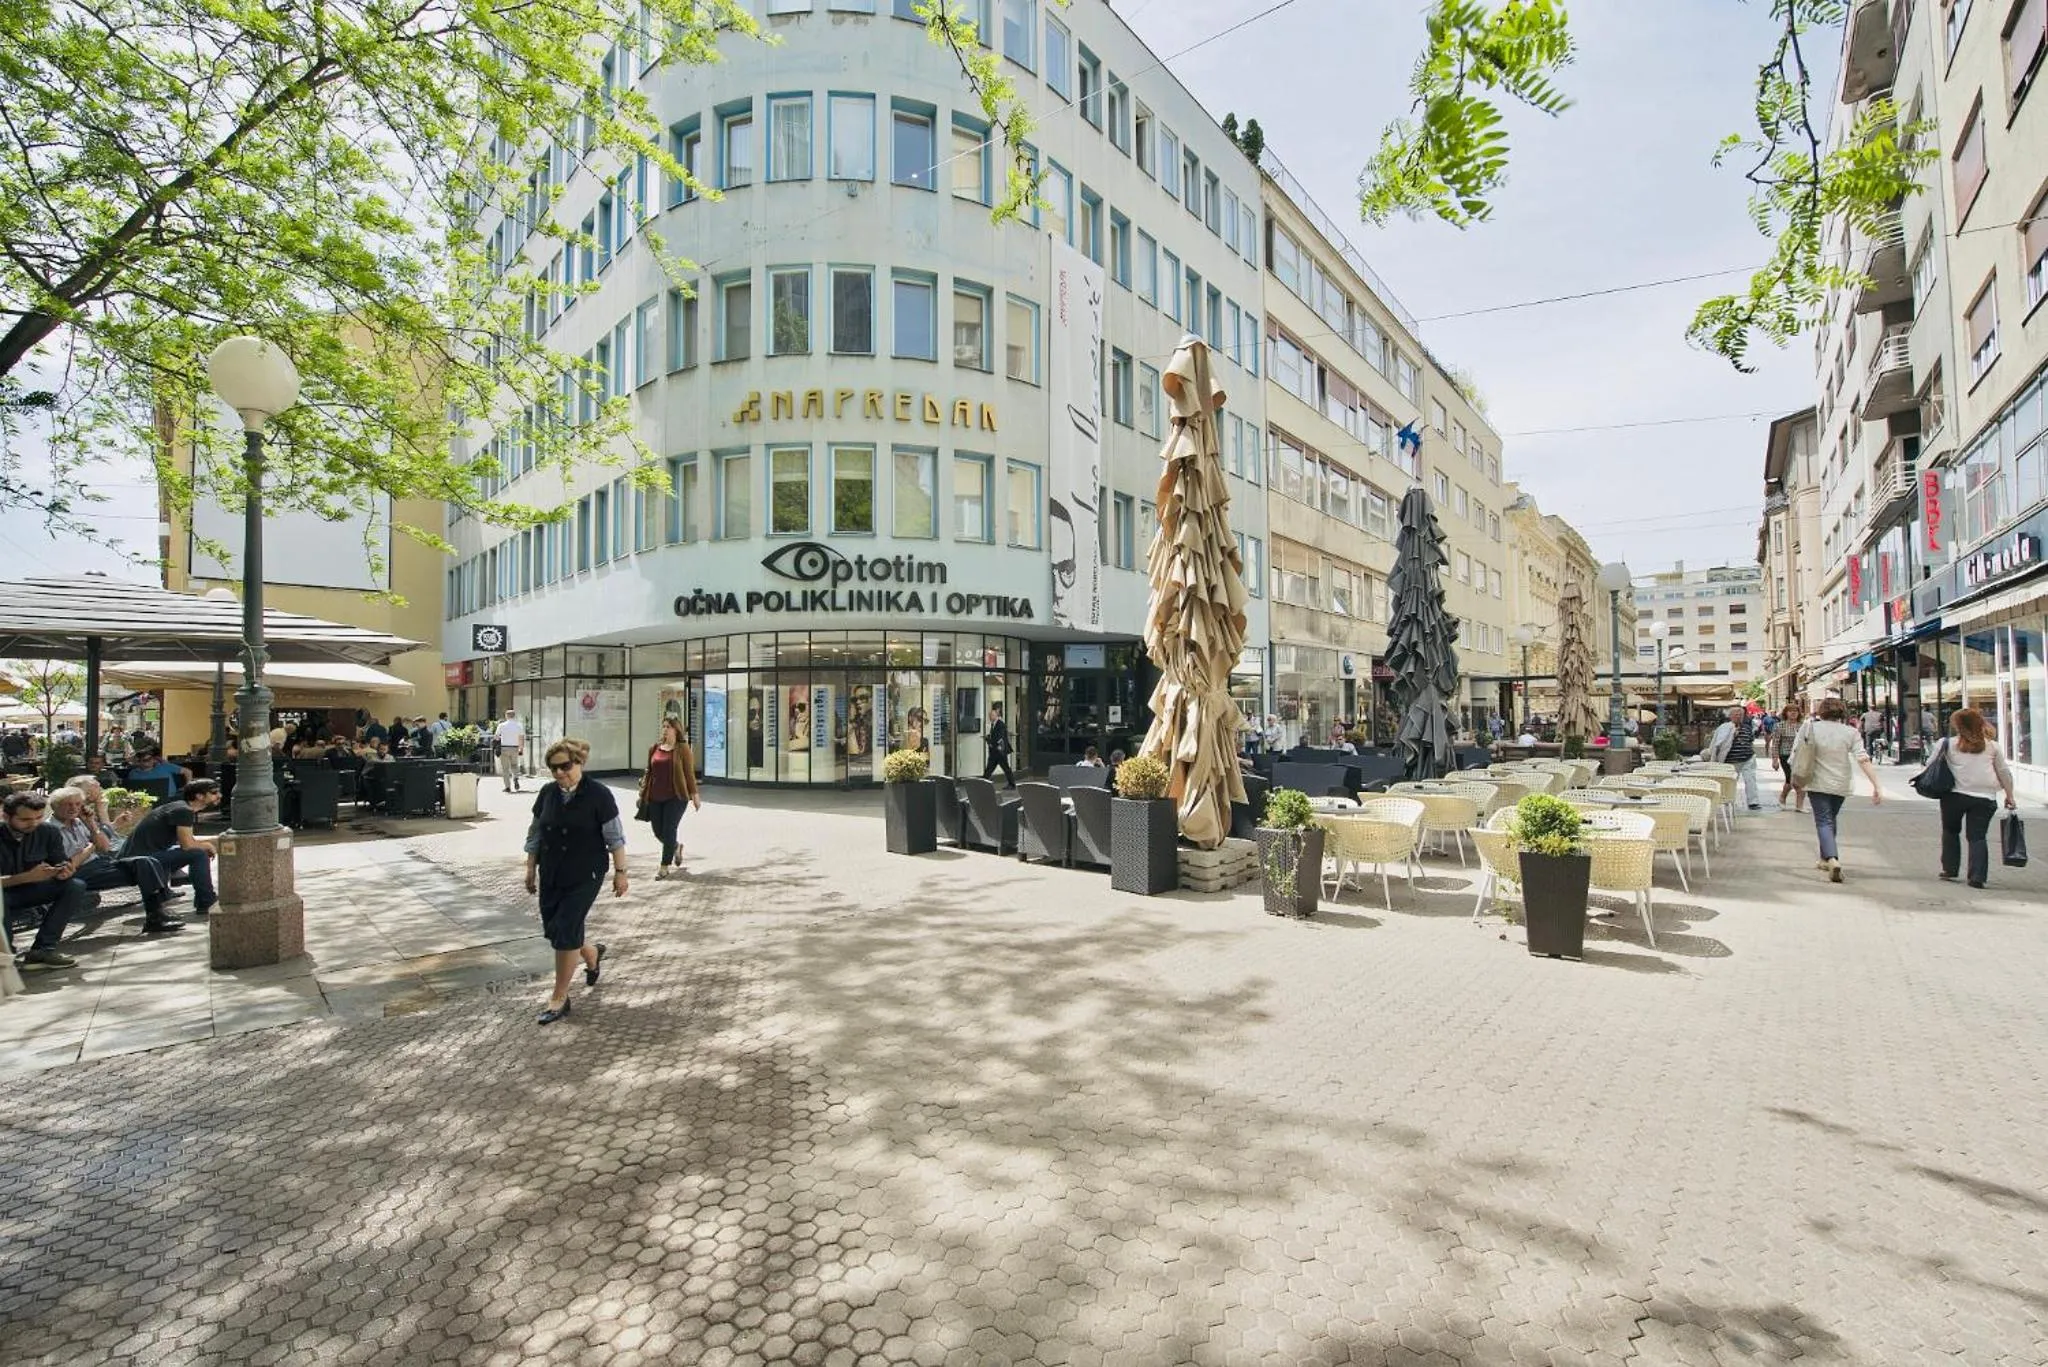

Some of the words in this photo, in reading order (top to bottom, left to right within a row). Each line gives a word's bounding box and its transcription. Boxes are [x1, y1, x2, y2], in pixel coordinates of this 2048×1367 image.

[792, 543, 947, 588] Optotim
[674, 588, 741, 617] OČNA
[746, 589, 925, 613] POLIKLINIKA
[932, 591, 938, 613] I
[945, 592, 1034, 618] OPTIKA
